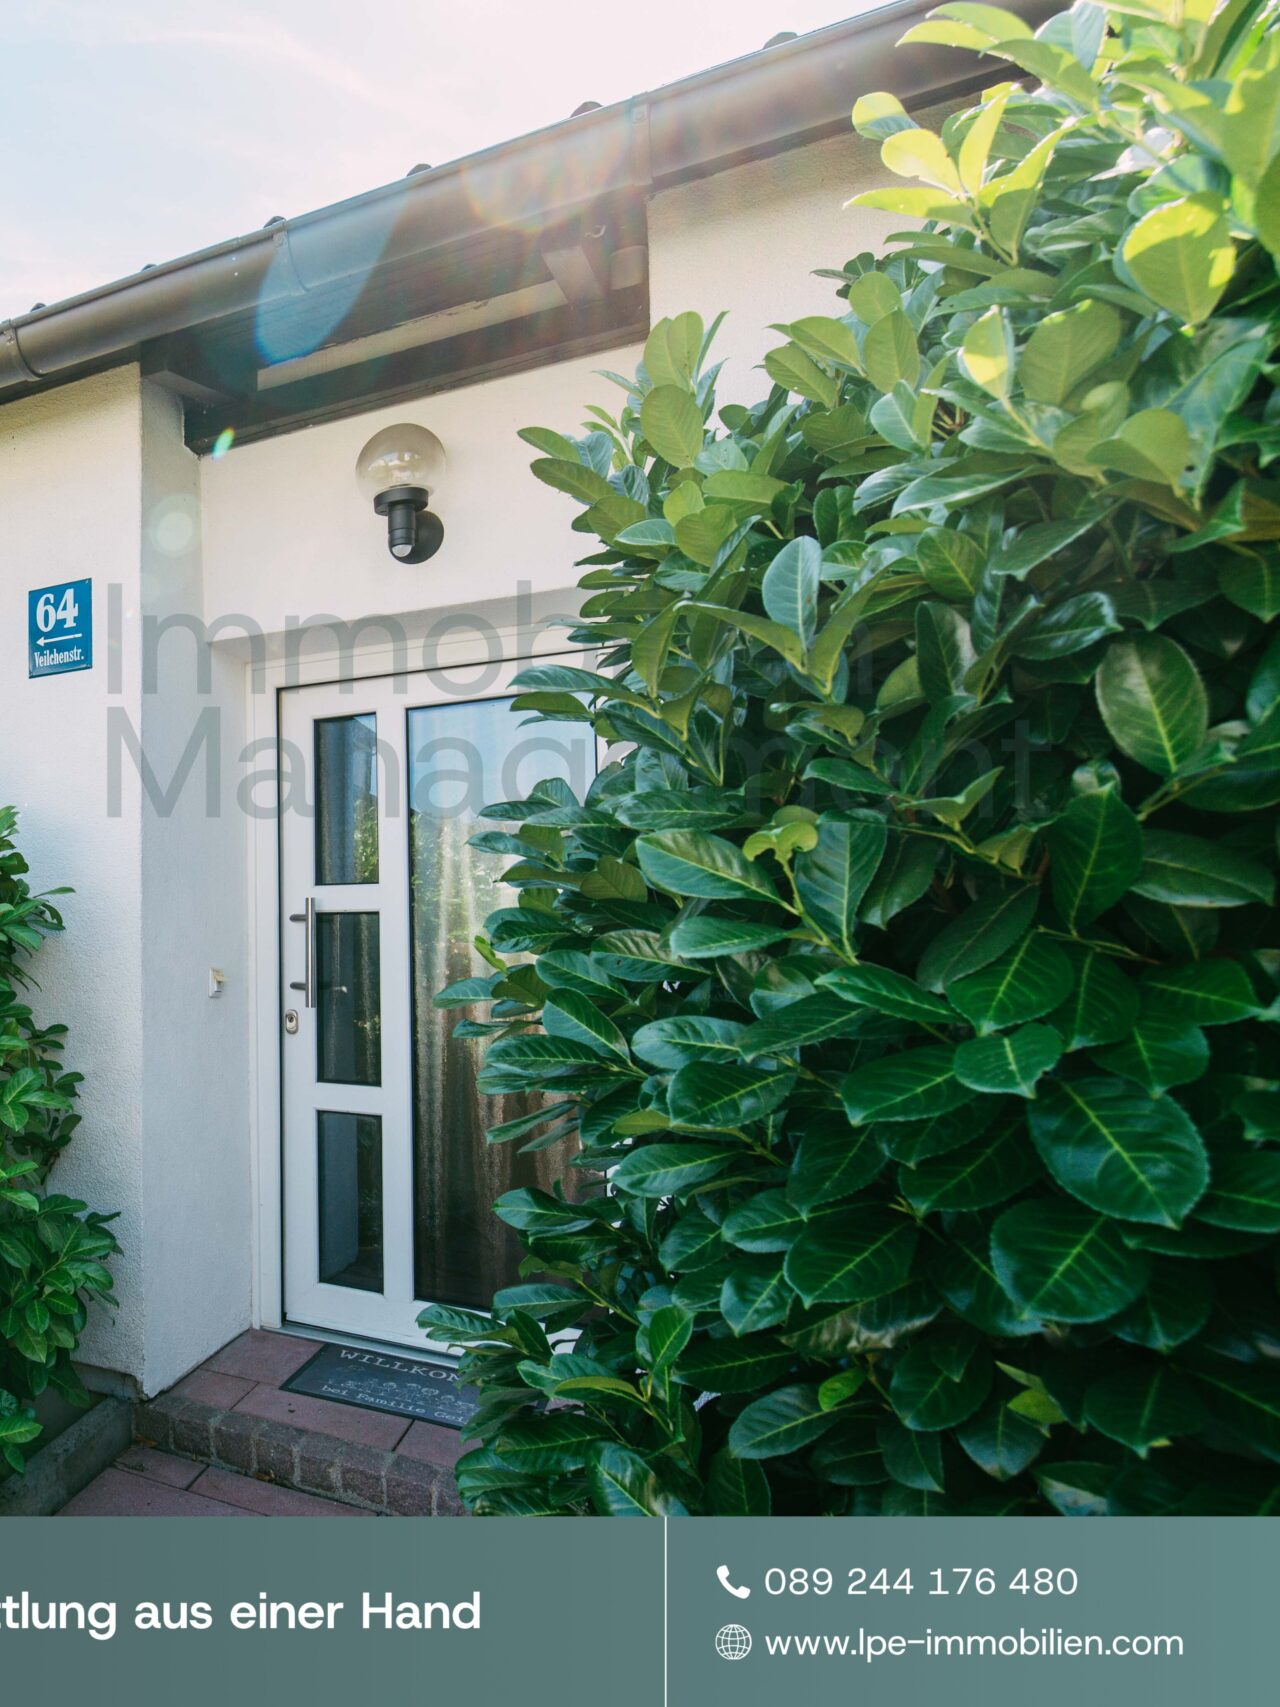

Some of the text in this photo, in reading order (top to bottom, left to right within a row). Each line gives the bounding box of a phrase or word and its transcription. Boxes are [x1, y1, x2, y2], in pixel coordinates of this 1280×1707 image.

[35, 587, 79, 633] 64
[33, 645, 85, 669] Veilchenstr.
[322, 1384, 468, 1425] bei Familie Gei
